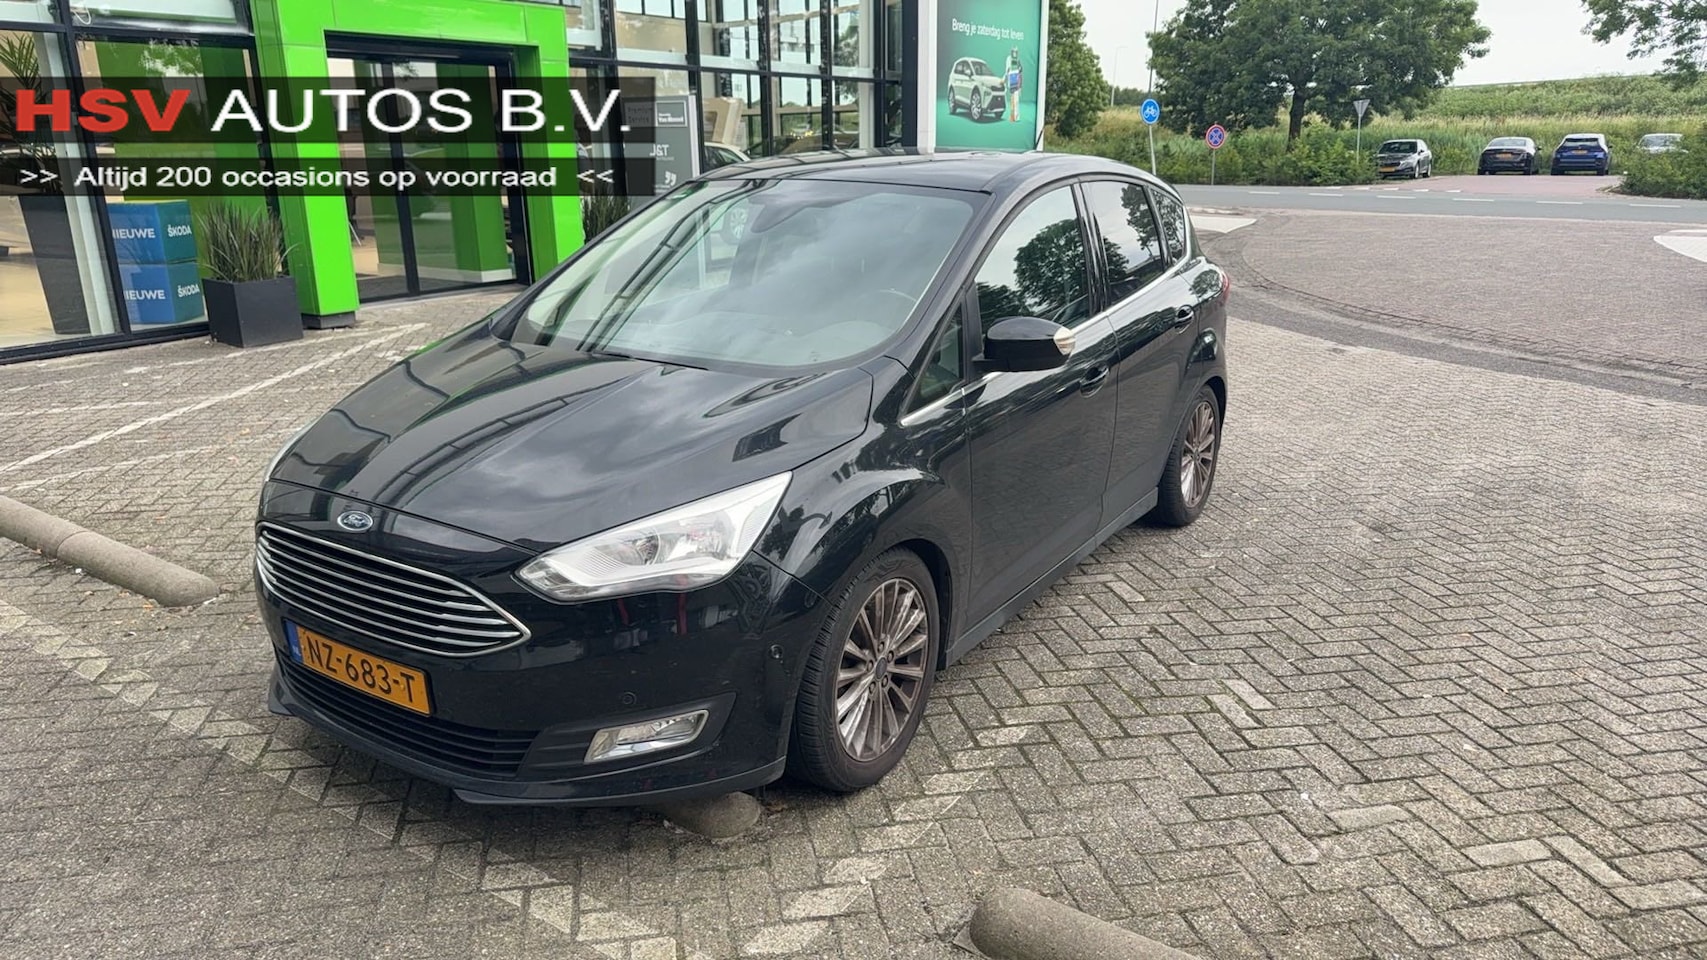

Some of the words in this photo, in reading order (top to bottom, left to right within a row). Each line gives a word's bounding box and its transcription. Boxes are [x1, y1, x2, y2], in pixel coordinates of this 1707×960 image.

[952, 18, 970, 36] Breng
[970, 22, 976, 36] je
[977, 25, 1001, 40] zaterdag
[1001, 28, 1009, 39] tot
[1010, 28, 1024, 40] leven
[167, 224, 192, 238] ŠKODA
[125, 289, 166, 301] IEUWE
[177, 284, 200, 298] ŠKODA
[343, 513, 367, 528] Ford
[306, 635, 415, 704] NZ-683-T
